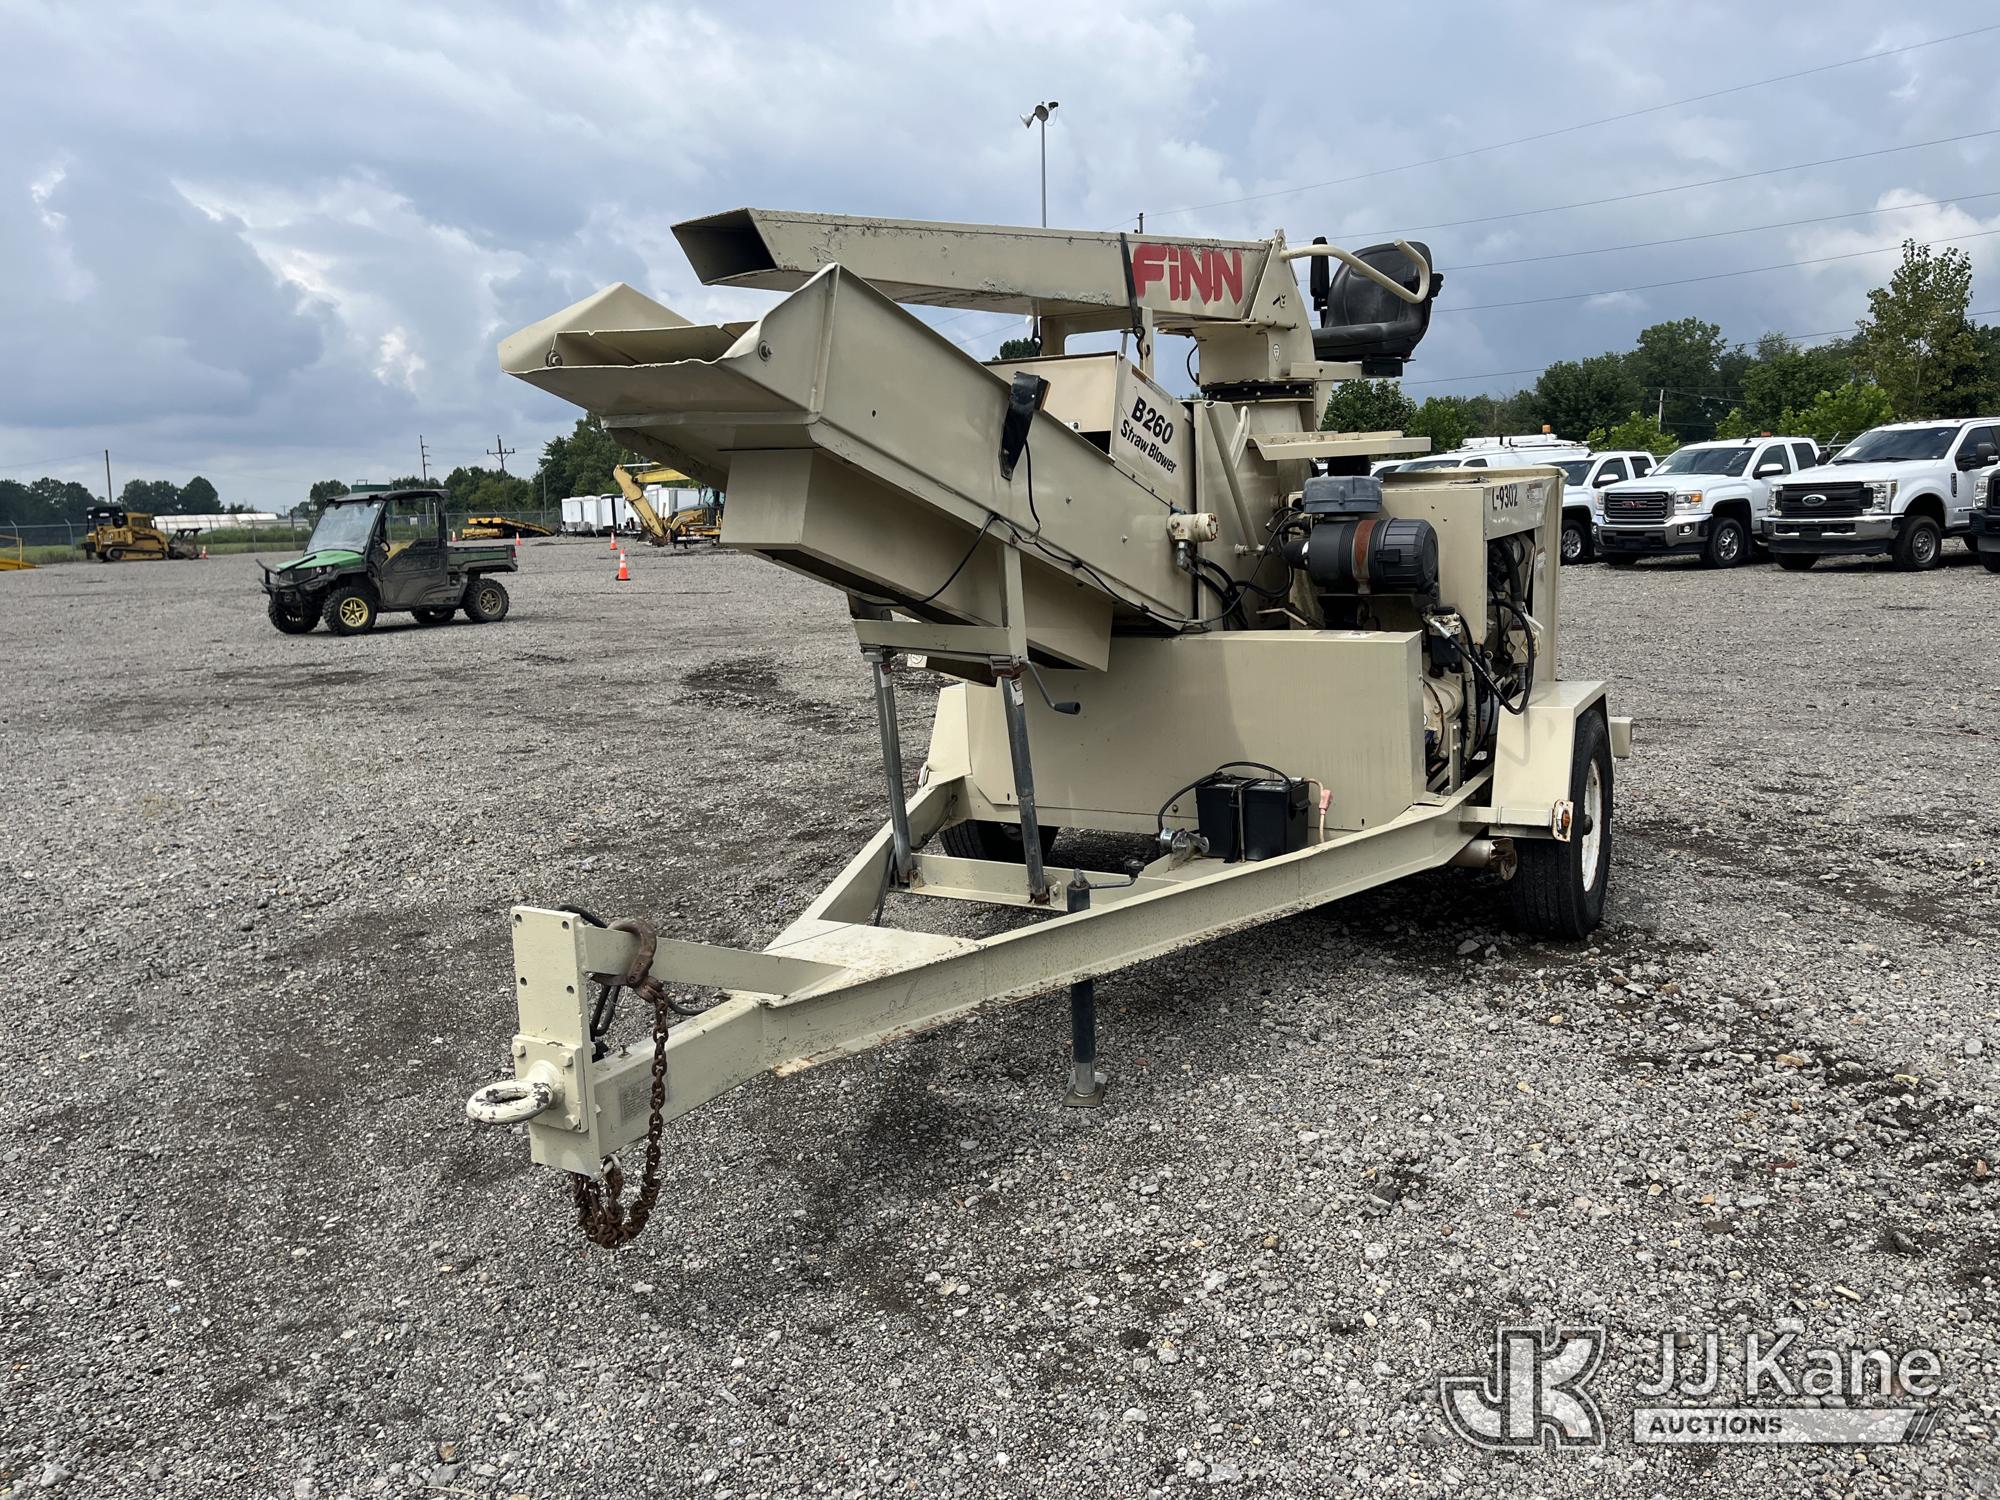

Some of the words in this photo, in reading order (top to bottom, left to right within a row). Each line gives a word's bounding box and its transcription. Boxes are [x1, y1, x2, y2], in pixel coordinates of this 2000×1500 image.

[1131, 396, 1174, 444] B260
[1120, 419, 1149, 453] Straw
[1147, 442, 1177, 474] Blower
[1492, 484, 1518, 511] L-9302
